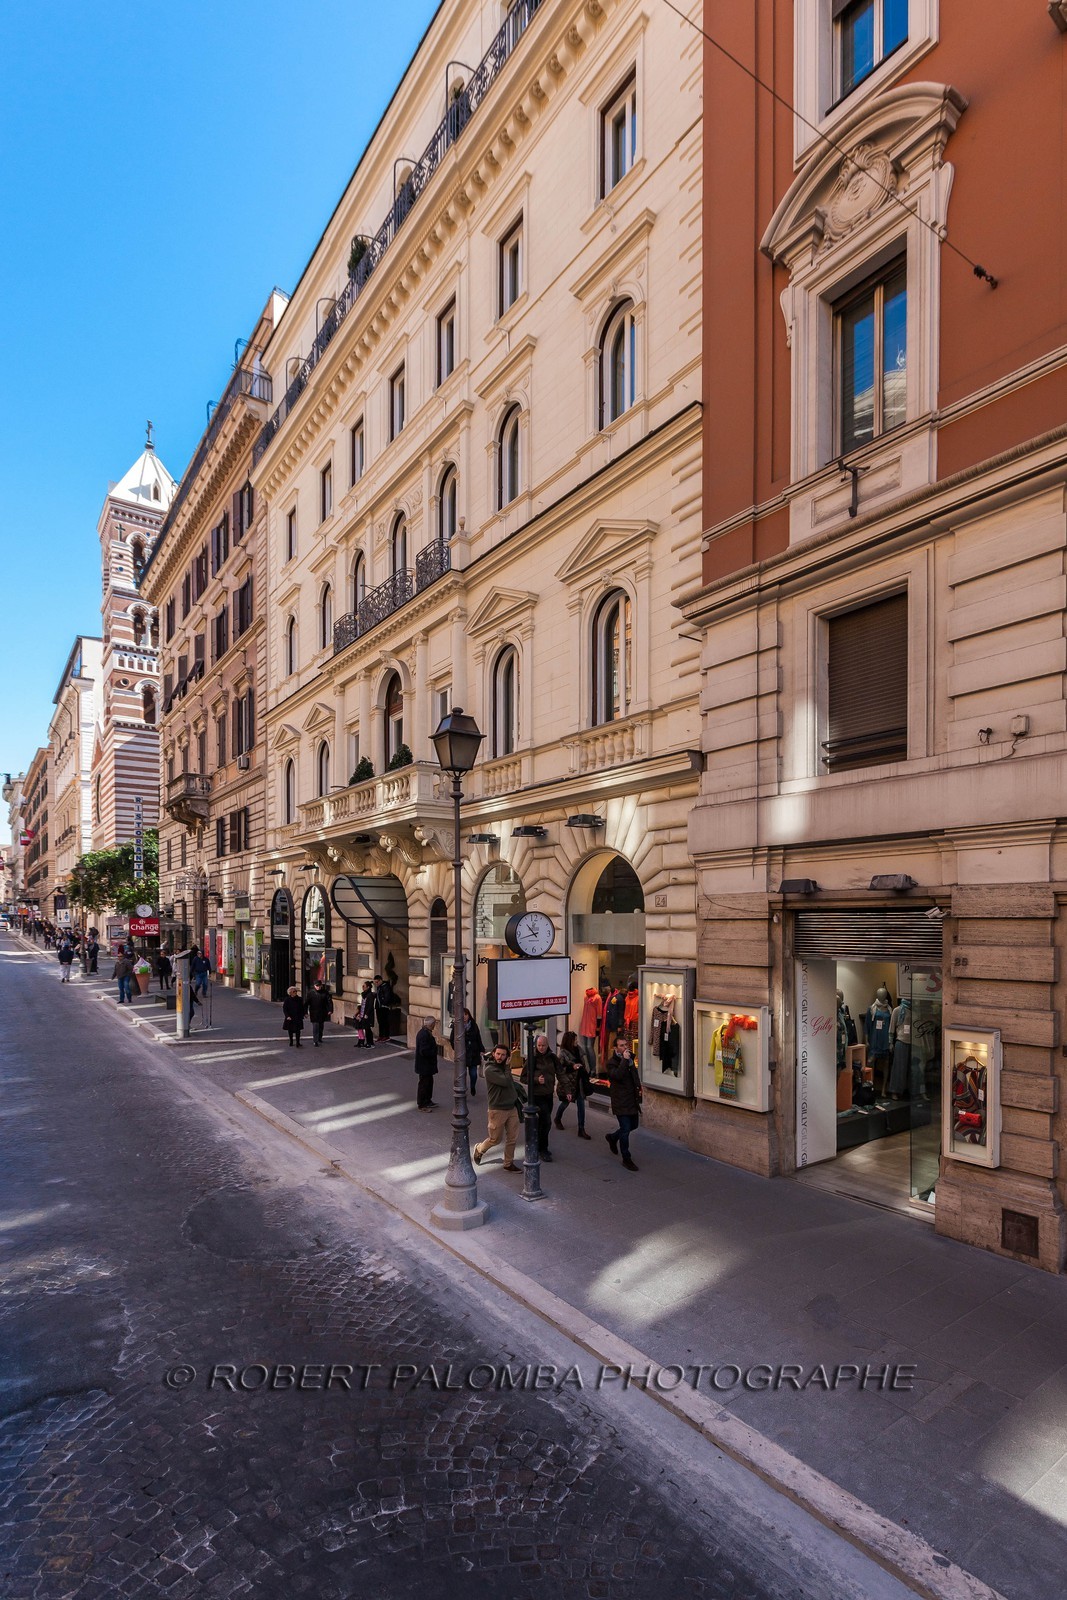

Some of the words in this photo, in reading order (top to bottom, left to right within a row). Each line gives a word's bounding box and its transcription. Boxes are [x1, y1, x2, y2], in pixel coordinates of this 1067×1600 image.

[655, 896, 666, 906] 24
[530, 914, 538, 922] 12
[130, 923, 159, 931] Change
[810, 1016, 833, 1036] Gilly
